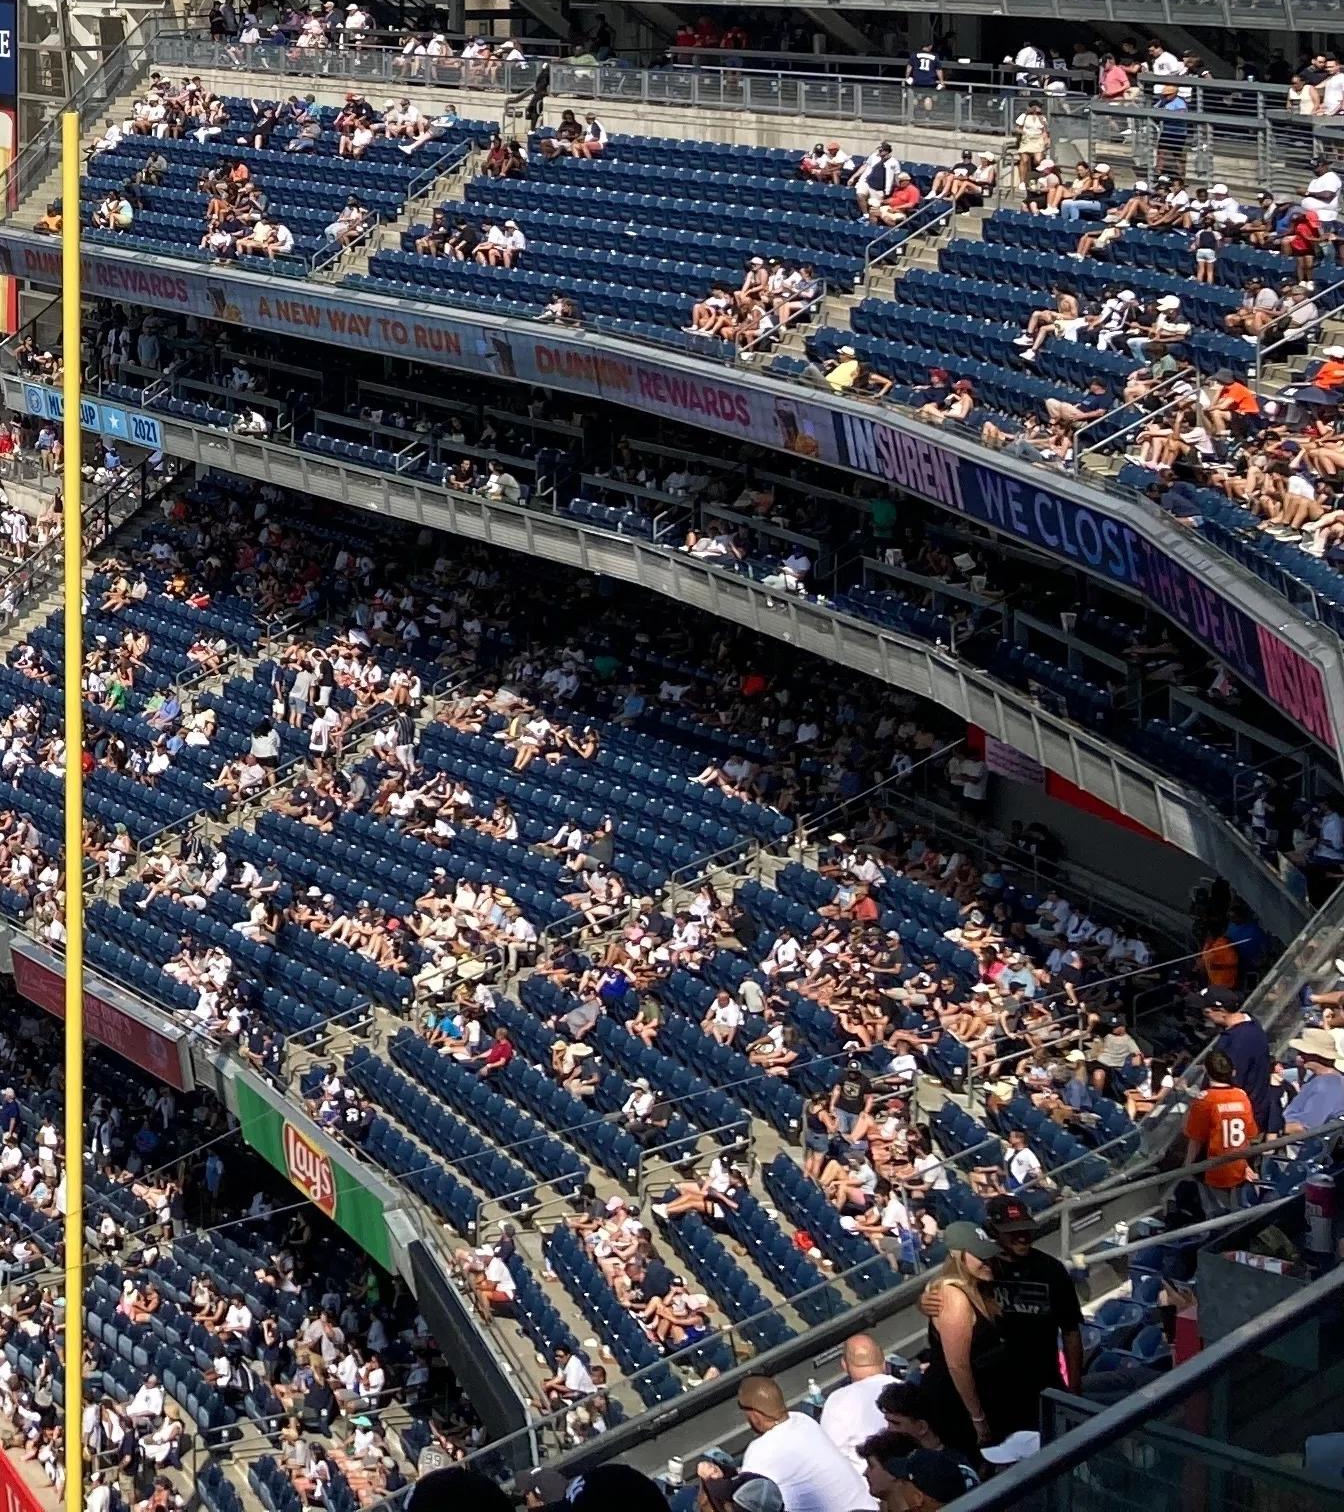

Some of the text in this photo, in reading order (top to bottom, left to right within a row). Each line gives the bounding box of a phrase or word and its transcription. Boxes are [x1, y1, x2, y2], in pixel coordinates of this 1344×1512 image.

[96, 267, 189, 302] REWARDS
[258, 296, 462, 356] A NEW WAY TO RUN
[637, 366, 751, 426] REWARDS
[132, 417, 158, 444] 2021
[842, 413, 965, 510] INSURENT
[975, 466, 1029, 534] WE
[1034, 492, 1139, 583] CLOSE
[1222, 1118, 1245, 1148] 18
[288, 1126, 331, 1201] Lay's
